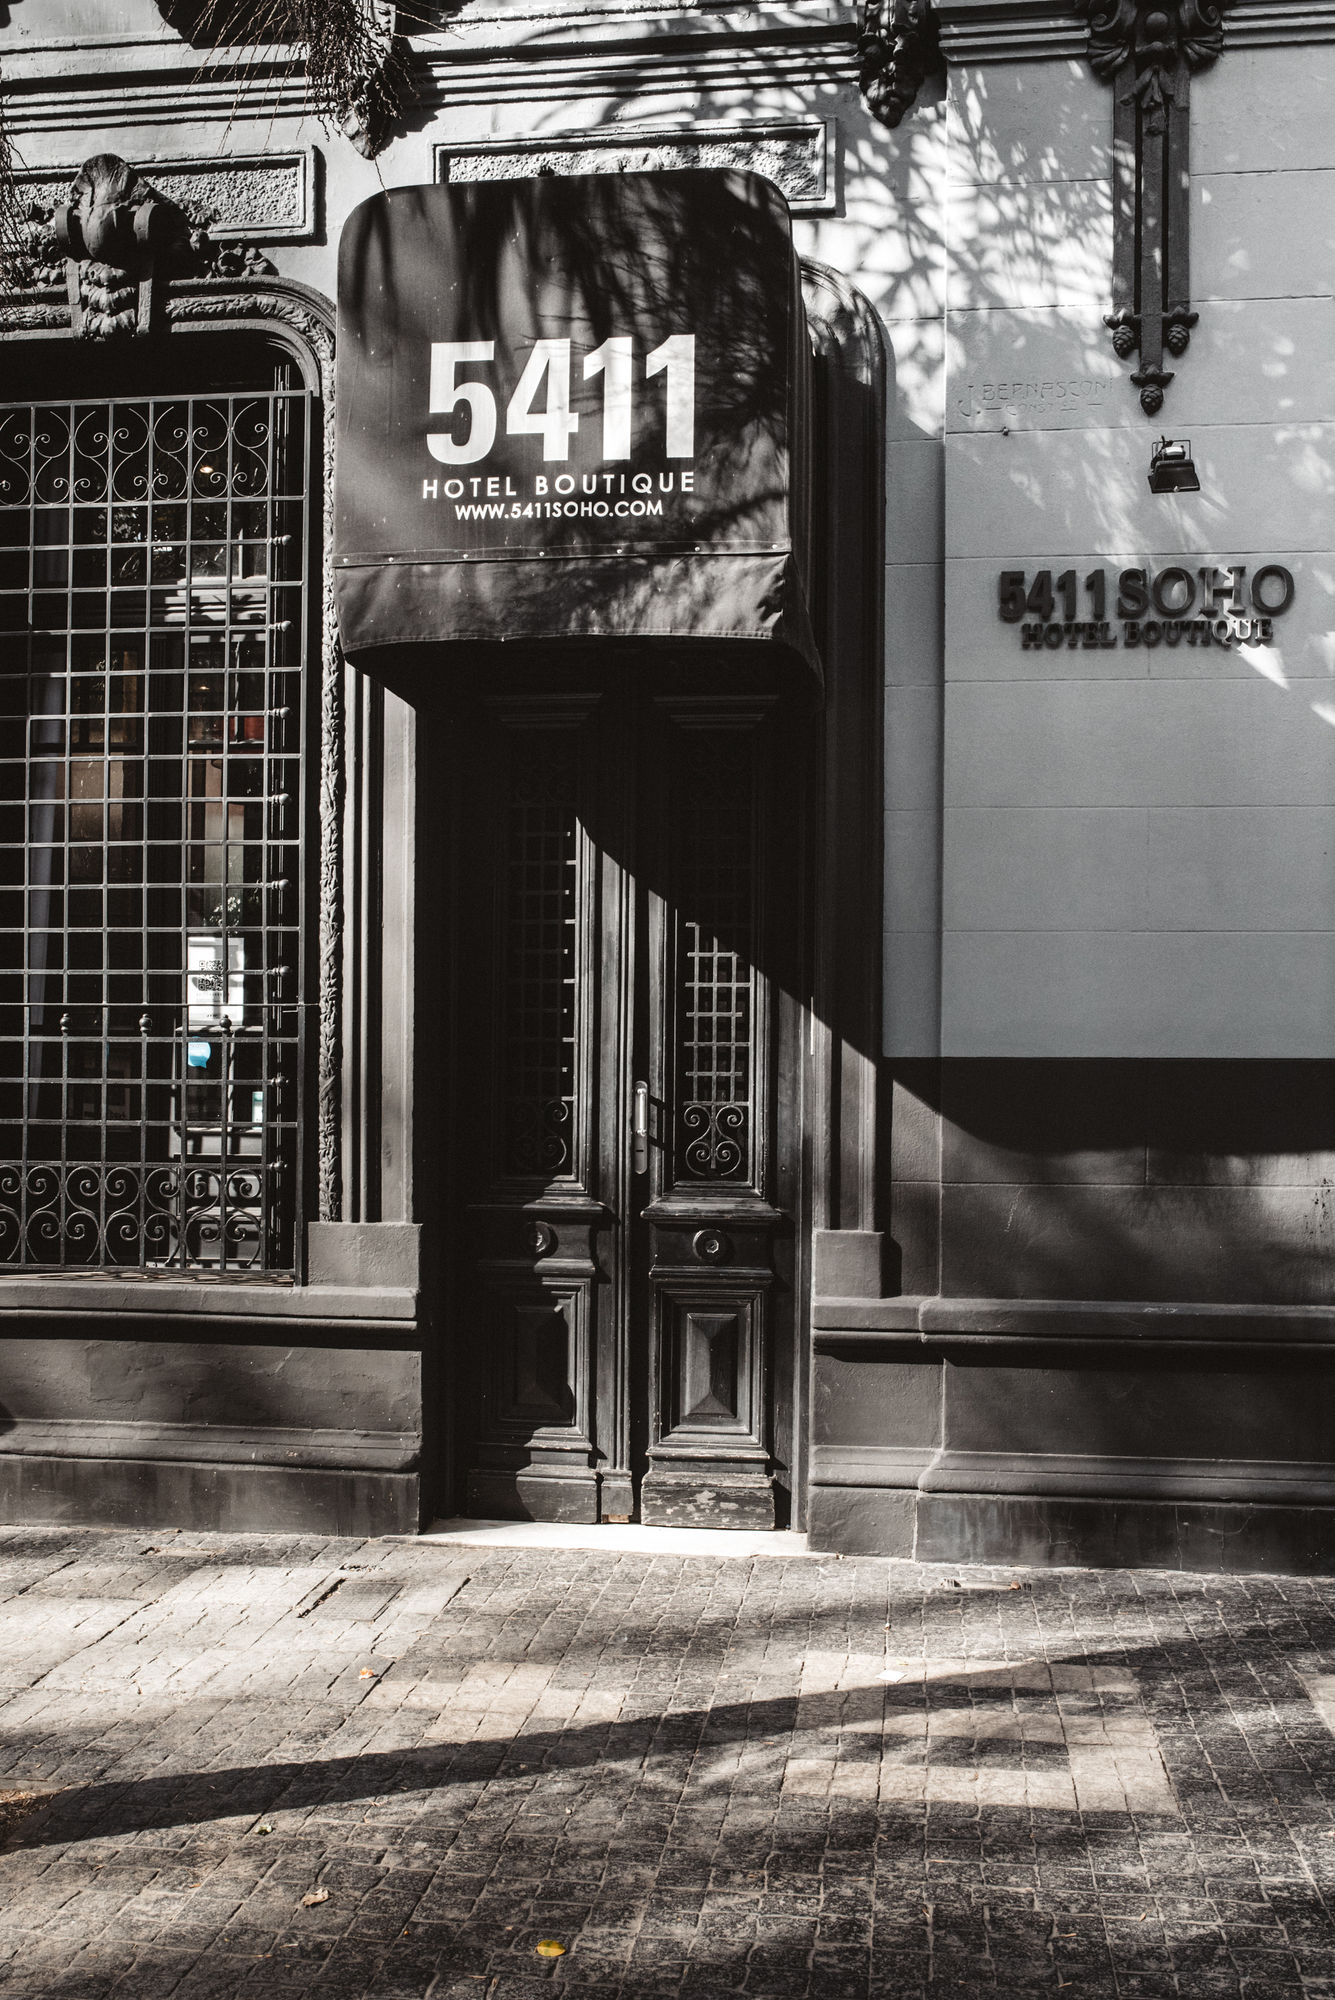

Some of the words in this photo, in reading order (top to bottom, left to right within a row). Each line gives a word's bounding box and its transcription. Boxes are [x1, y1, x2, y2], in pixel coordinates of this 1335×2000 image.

[426, 334, 695, 465] 5411
[422, 477, 517, 499] HOTEL
[536, 471, 695, 497] BOUTIQUE
[455, 500, 663, 521] WWW.5411SOHO.COM
[1022, 620, 1117, 648] HOTEL
[1124, 617, 1274, 647] BOUTIQUE
